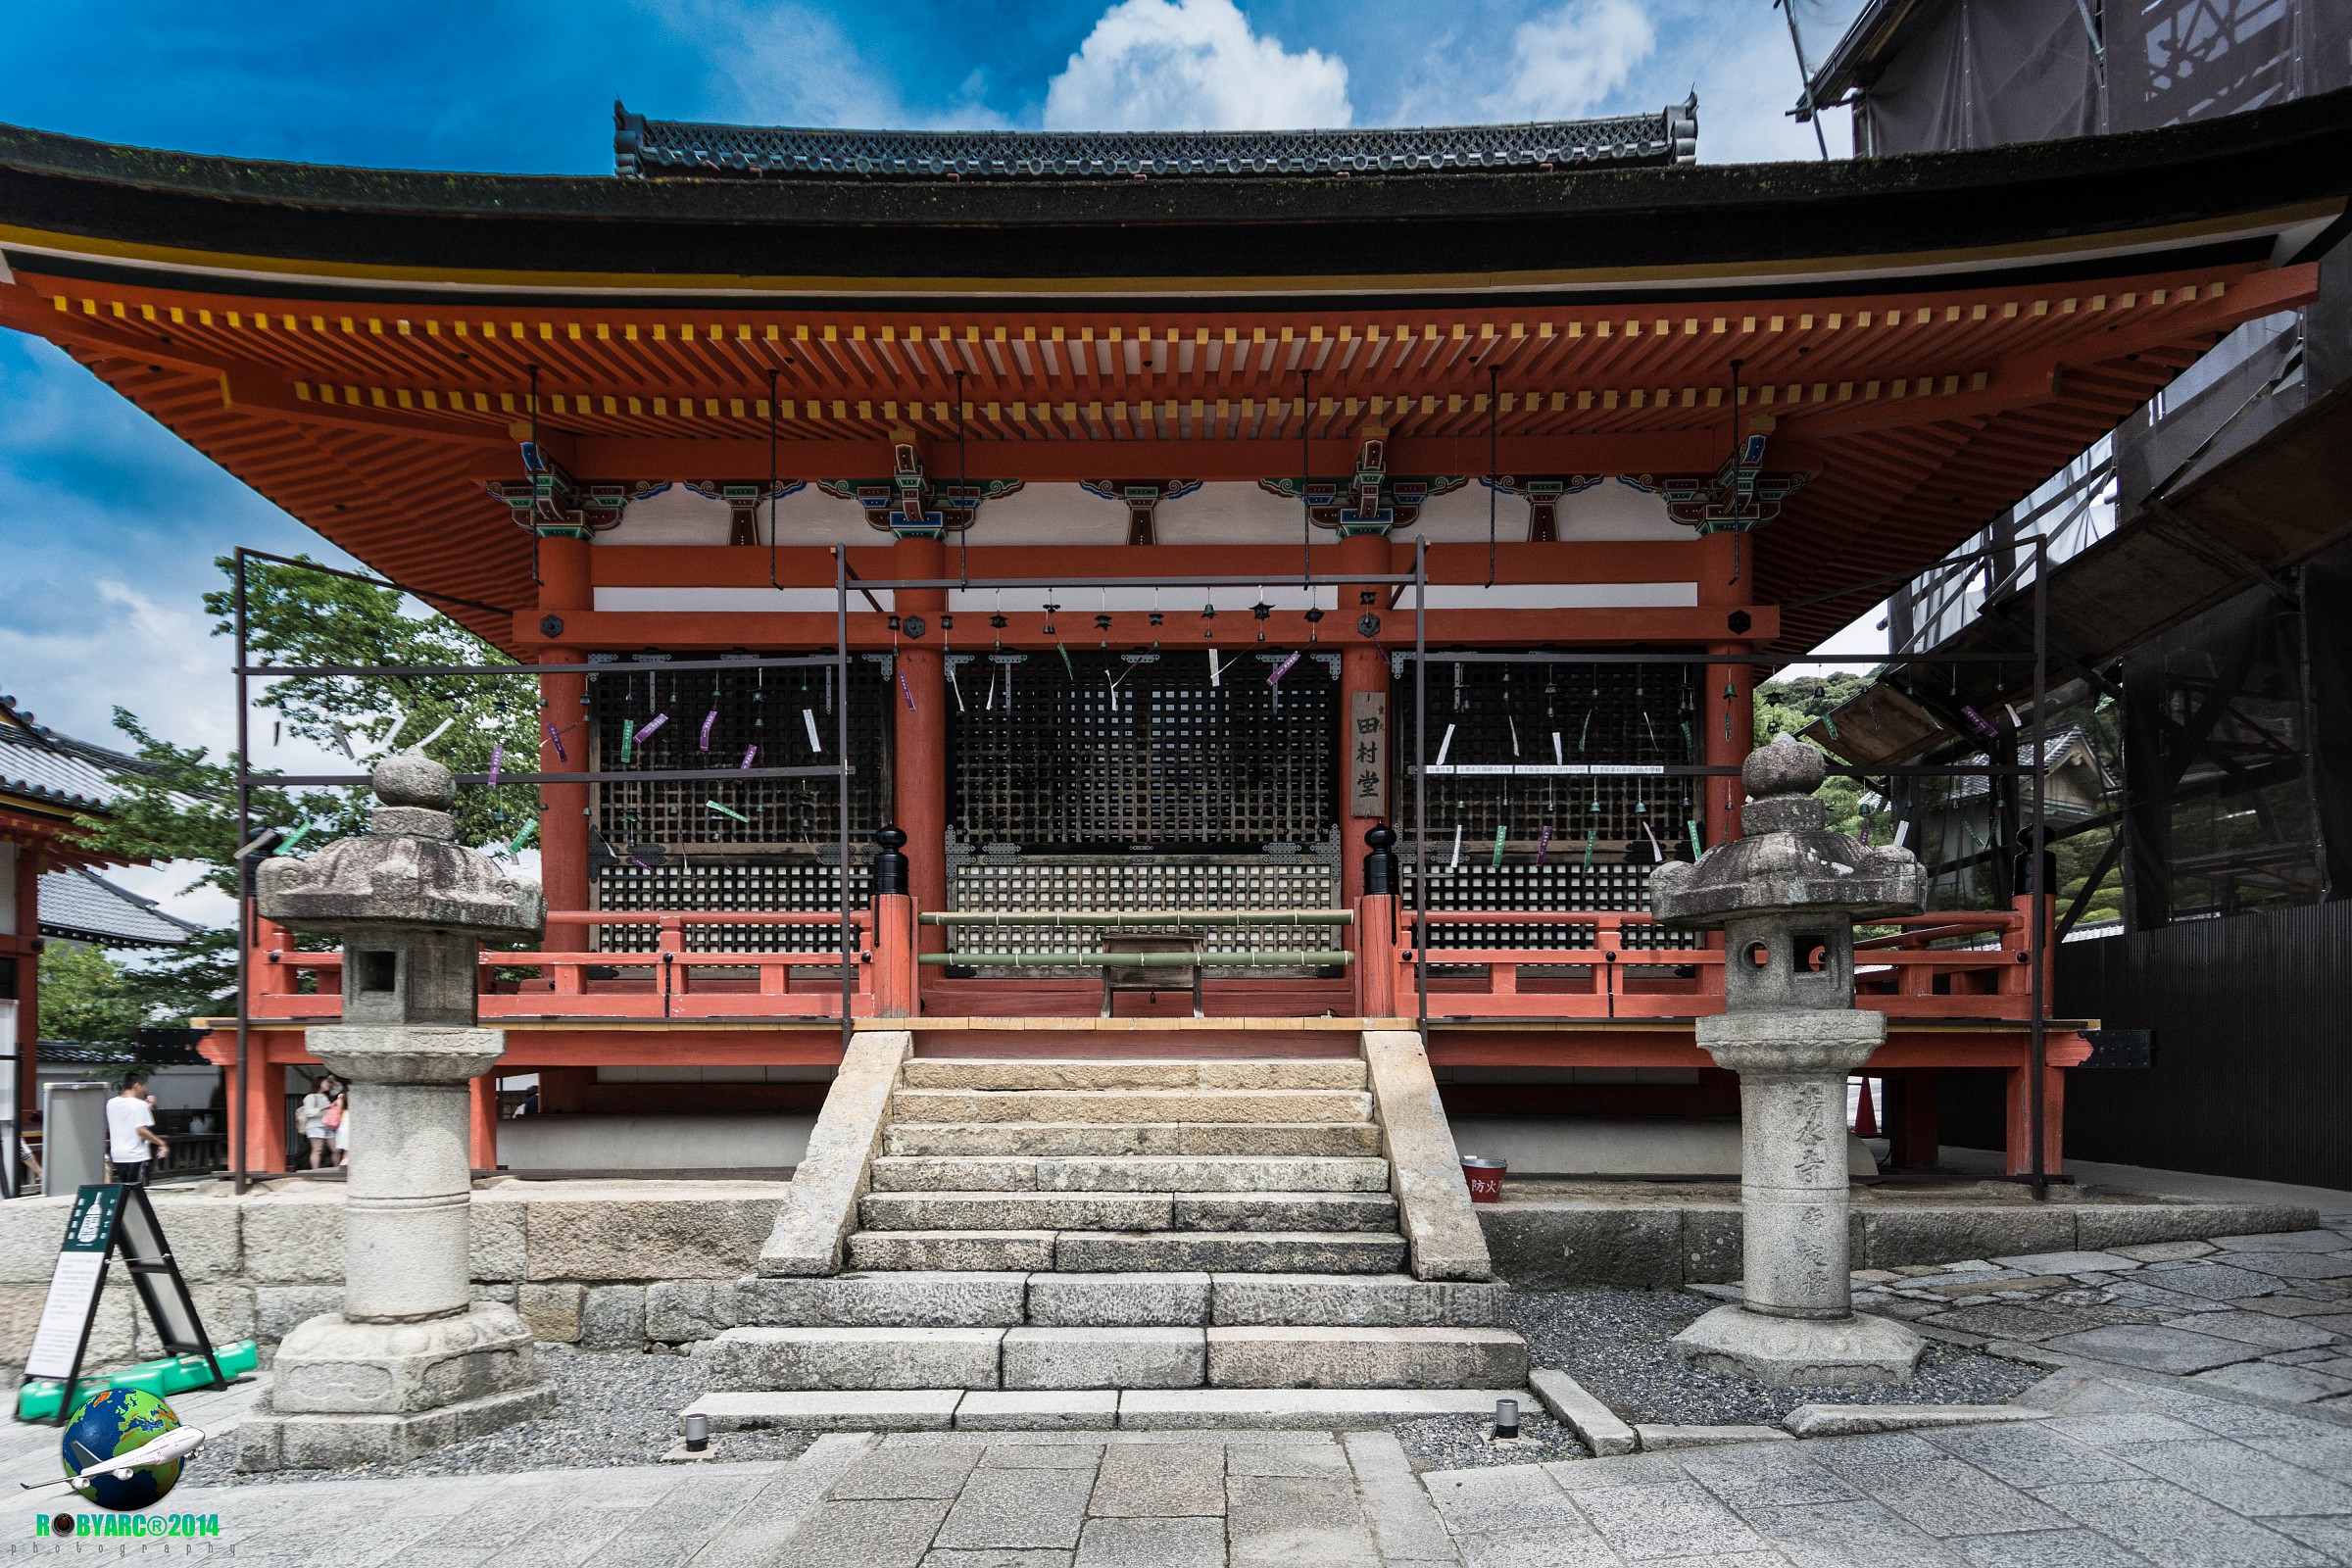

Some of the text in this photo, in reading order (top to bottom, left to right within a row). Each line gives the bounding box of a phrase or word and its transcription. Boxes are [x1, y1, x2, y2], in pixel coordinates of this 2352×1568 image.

[1355, 716, 1380, 798] 田村堂
[1793, 1082, 1827, 1184] 清水寺
